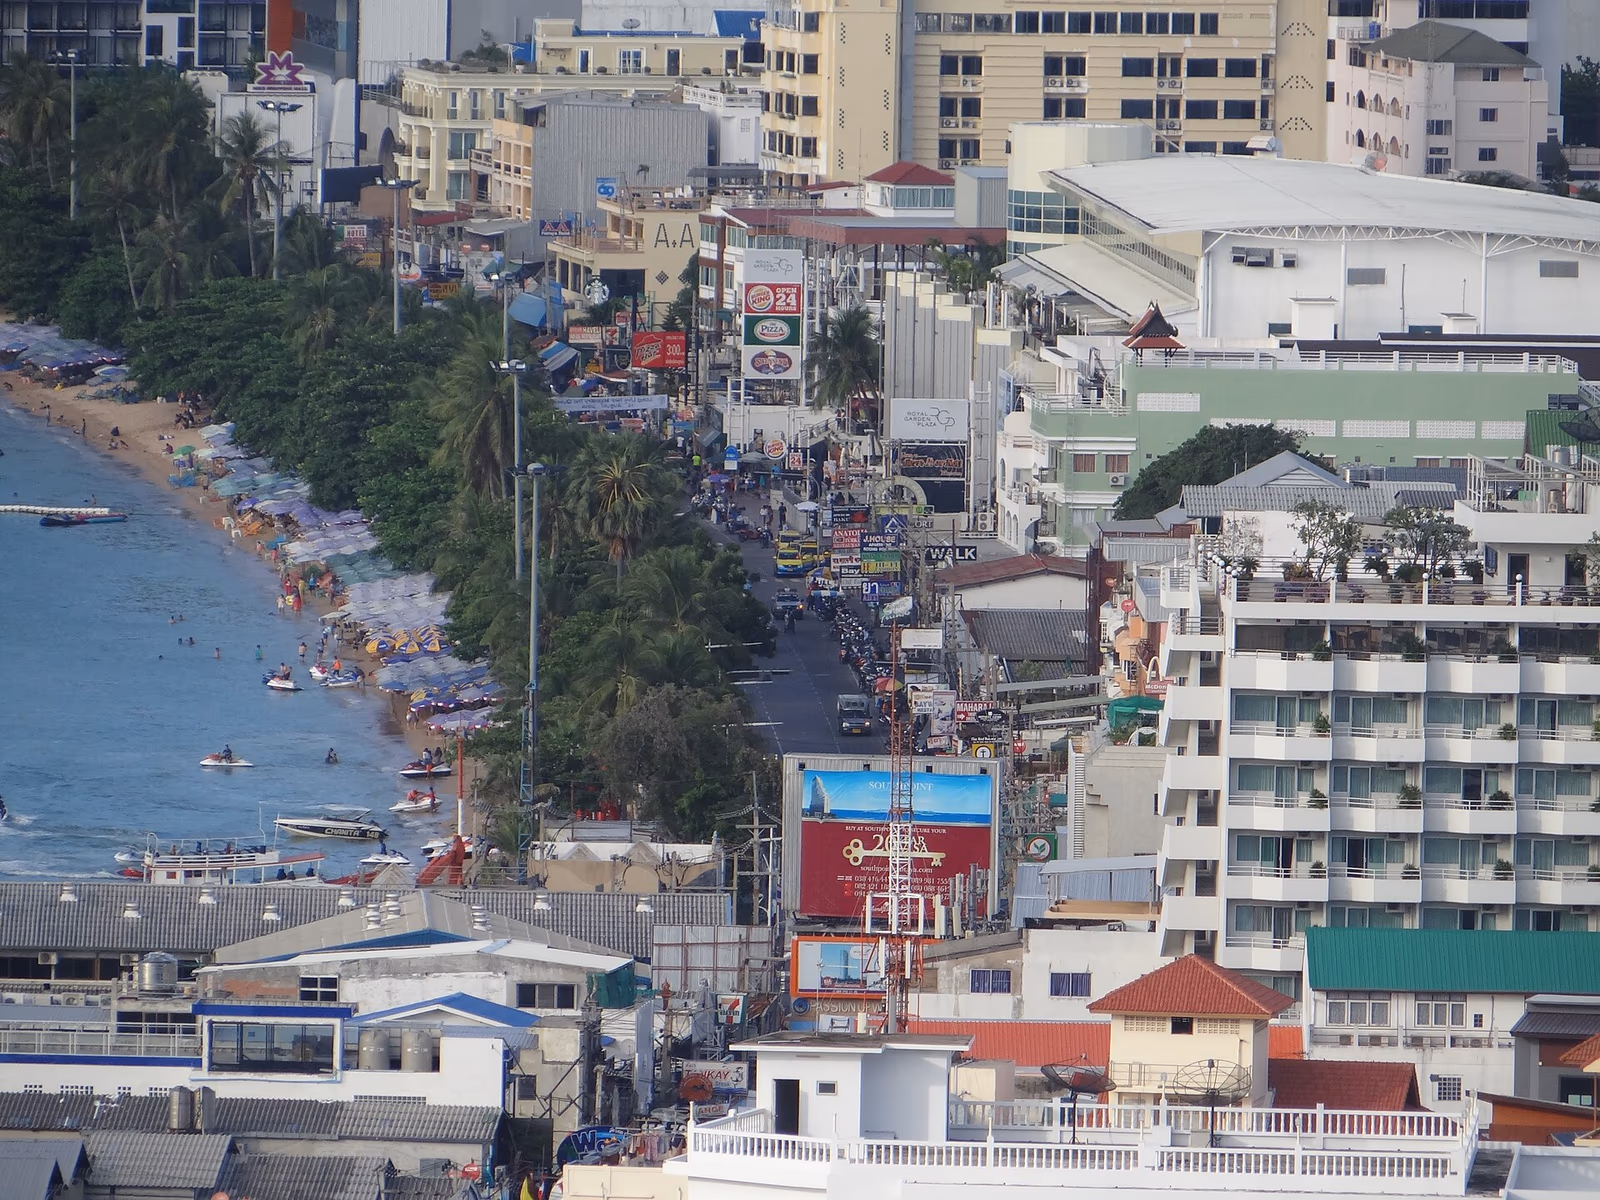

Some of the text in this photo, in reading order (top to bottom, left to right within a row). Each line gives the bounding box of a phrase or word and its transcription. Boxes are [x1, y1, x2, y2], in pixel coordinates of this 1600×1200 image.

[751, 294, 797, 306] KING 24
[790, 457, 802, 465] 24
[366, 831, 379, 839] 148
